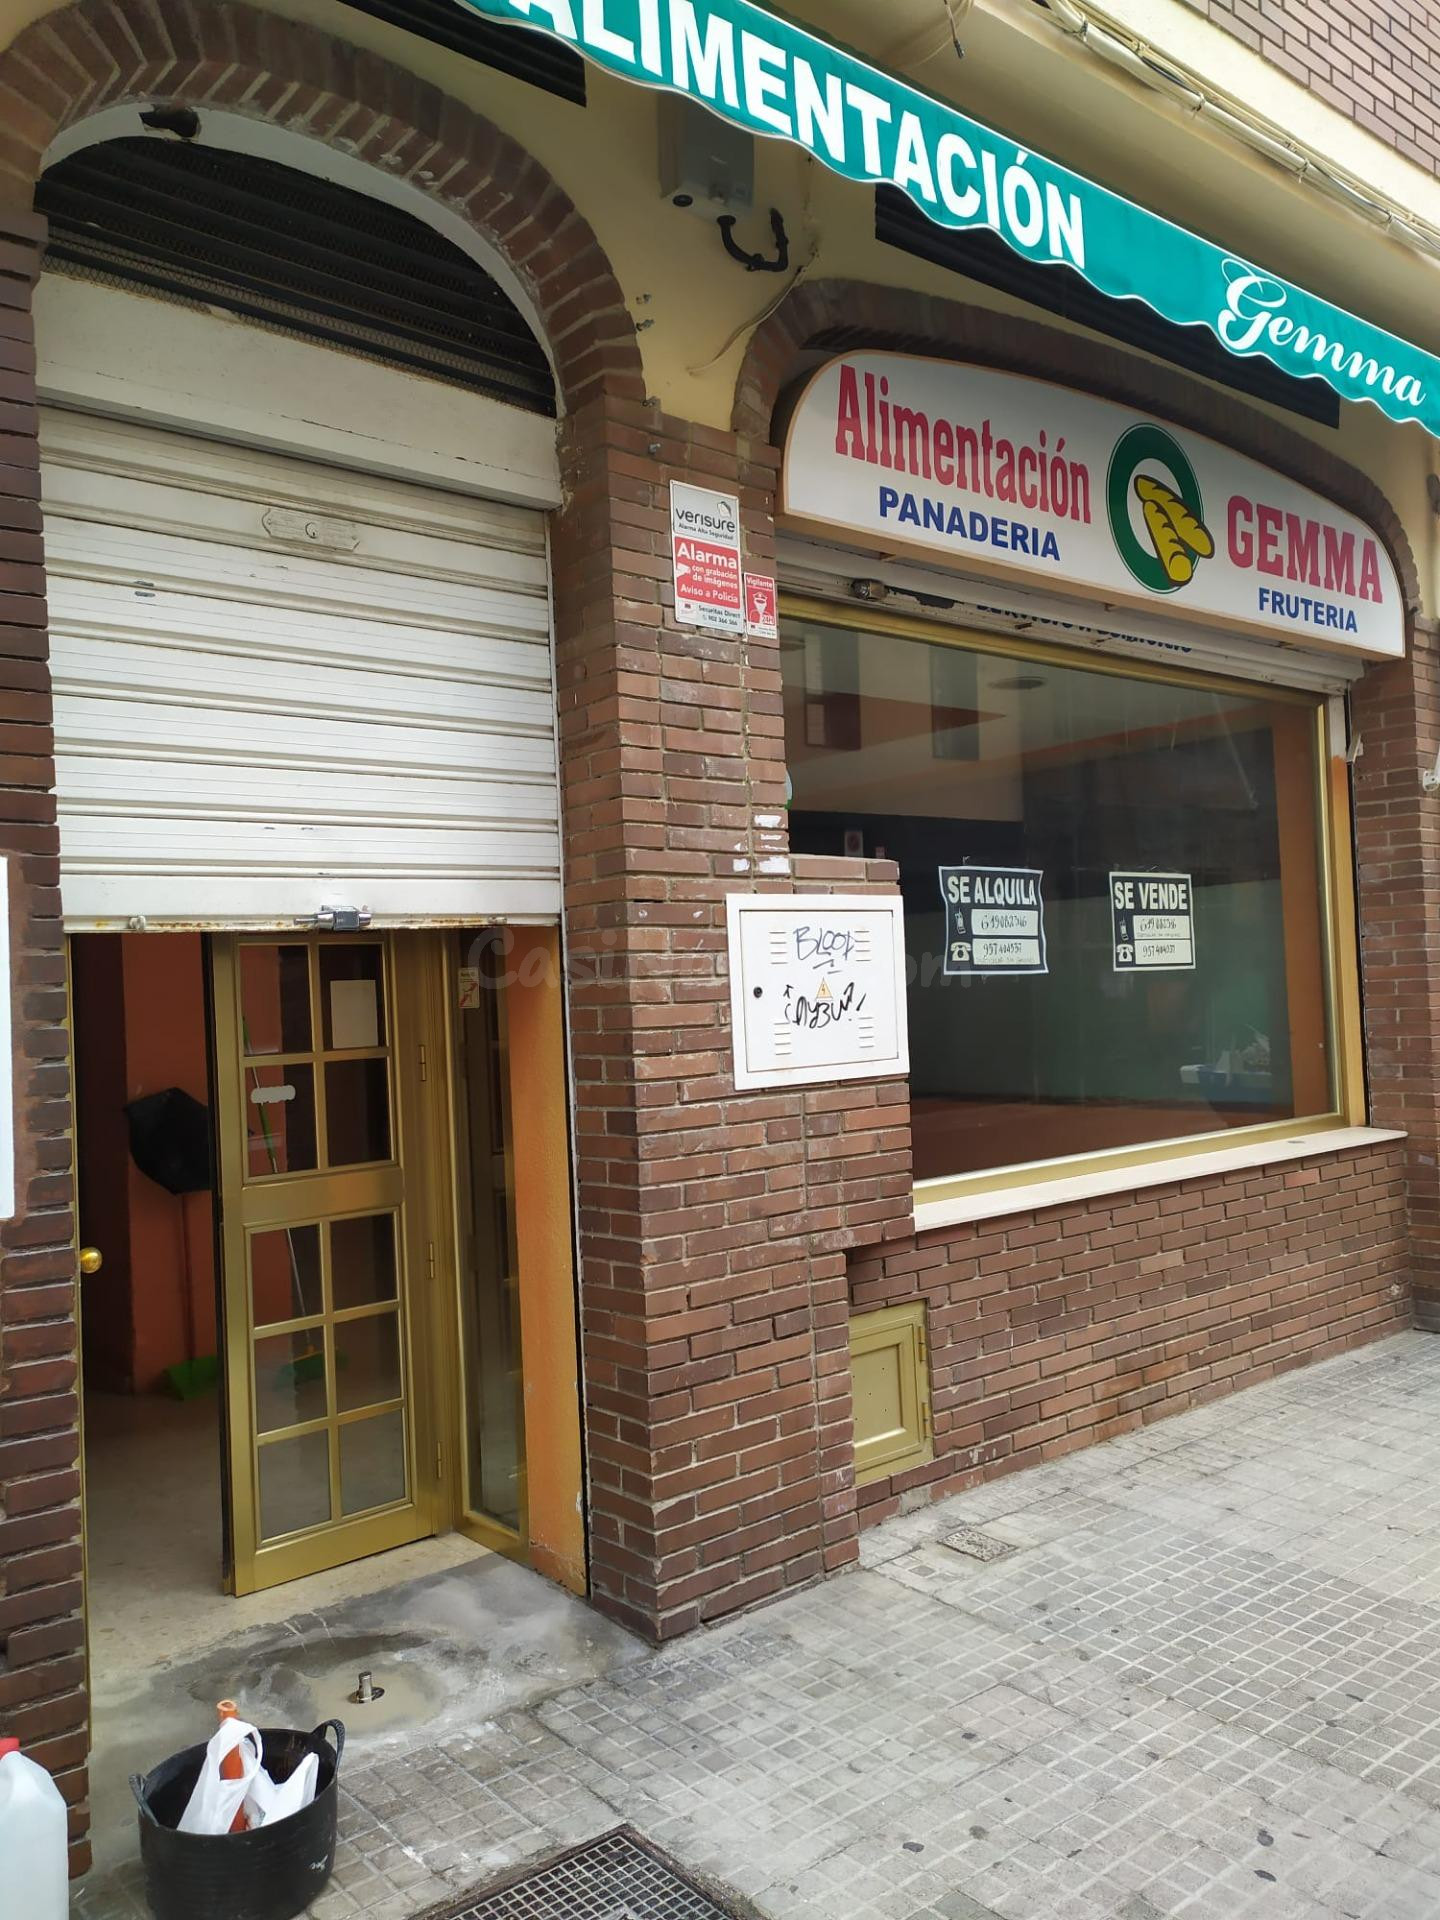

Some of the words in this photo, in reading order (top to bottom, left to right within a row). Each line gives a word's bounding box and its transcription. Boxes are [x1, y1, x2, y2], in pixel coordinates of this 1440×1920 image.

[1217, 258, 1427, 406] Gemma
[835, 363, 1091, 524] Alimentación
[675, 507, 736, 533] verisure
[878, 485, 1061, 561] PANADERIA
[677, 541, 737, 570] Alarma
[1227, 495, 1383, 604] GEMMA
[691, 564, 705, 574] con
[692, 572, 703, 582] de
[746, 575, 773, 589] Vigilante
[680, 583, 704, 597] Aviso
[705, 590, 711, 598] a
[1258, 587, 1358, 633] FRUTERIA
[947, 875, 971, 904] SE
[974, 876, 1037, 907] ALQUILA
[1114, 881, 1135, 910] SE
[1138, 882, 1188, 910] VENDE
